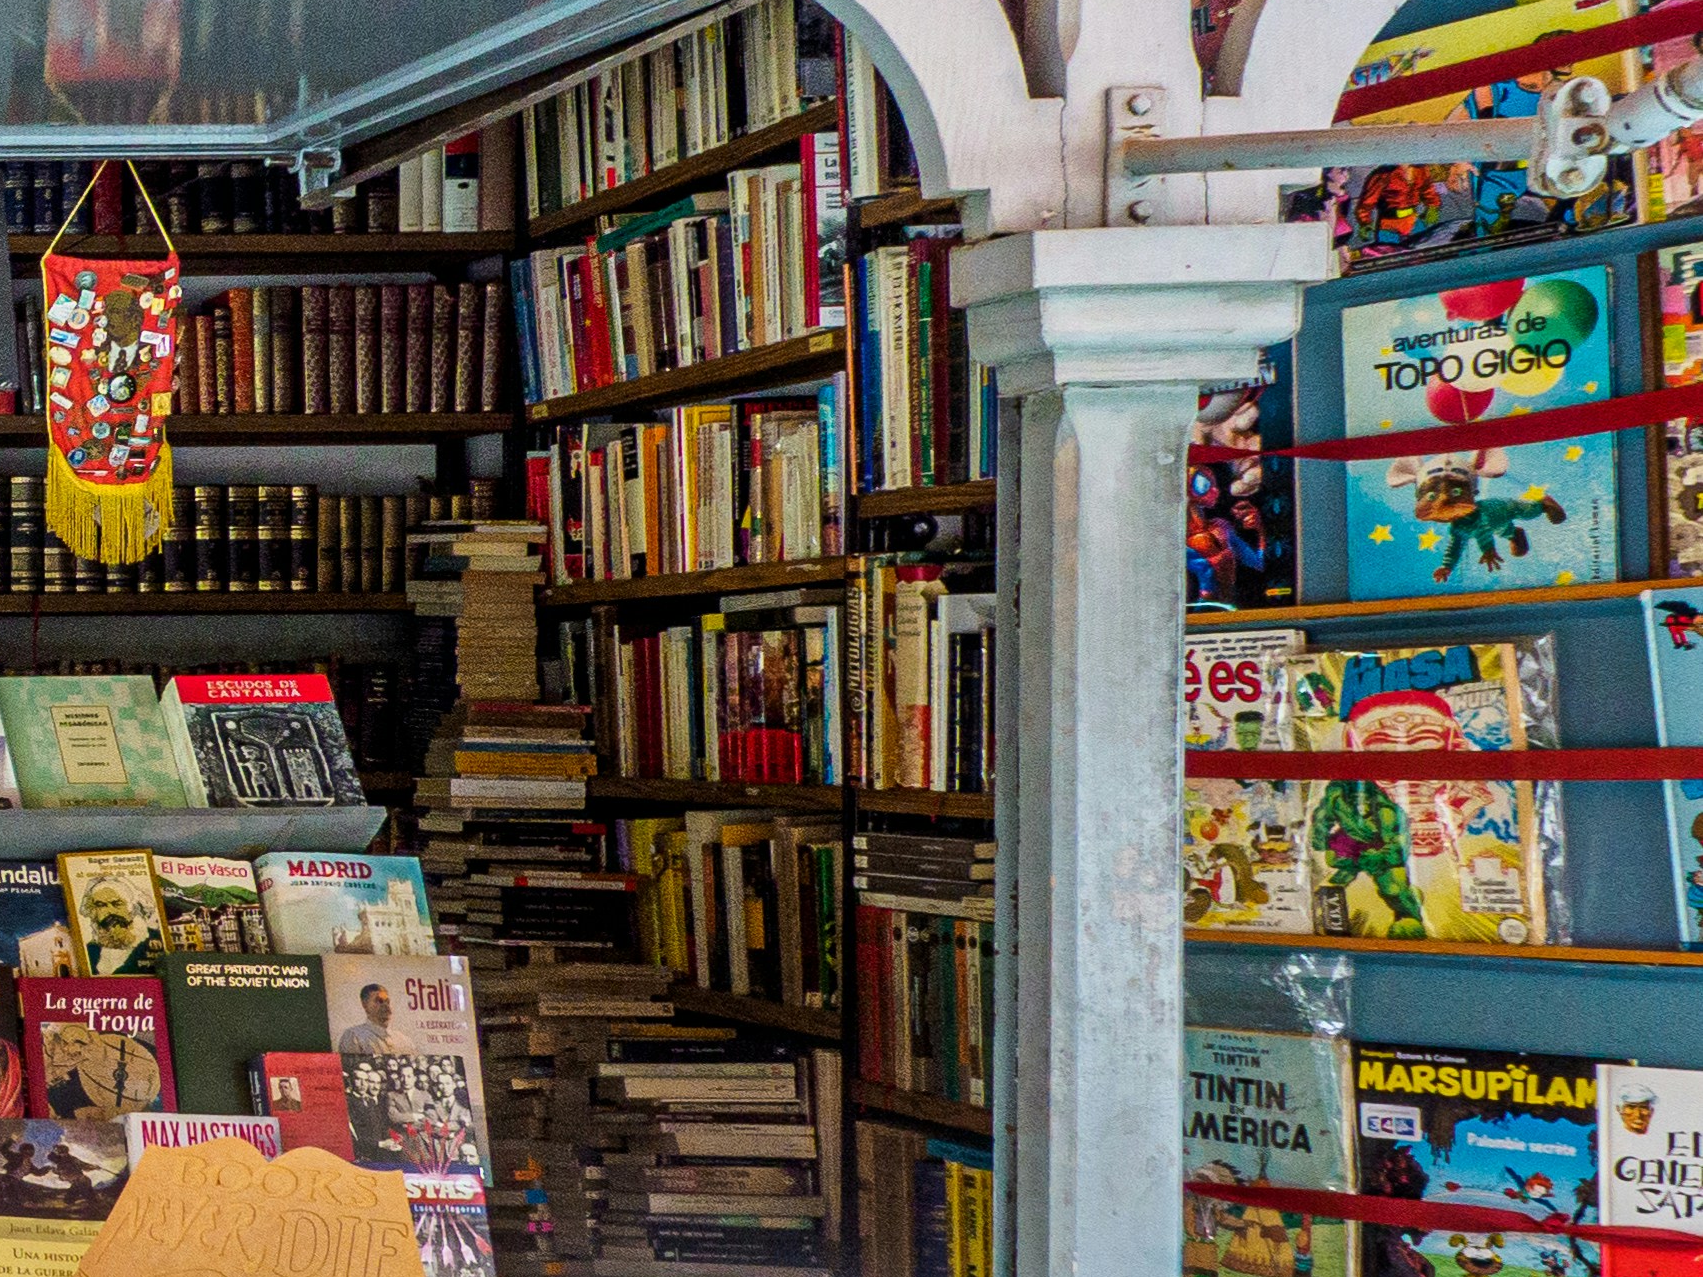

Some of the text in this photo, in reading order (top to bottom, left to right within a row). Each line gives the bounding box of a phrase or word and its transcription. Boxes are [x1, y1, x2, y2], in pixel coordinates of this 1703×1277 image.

[1392, 312, 1547, 353] aventuras de
[1374, 339, 1571, 391] TOPO GIGIO
[206, 680, 298, 691] ESCUDOS DE
[208, 687, 302, 699] CANTABRIA
[287, 859, 373, 881] MADRID
[186, 963, 309, 977] GREAT PATRIOTIC WAR
[187, 975, 311, 989] OF THE SOVIET UNION
[44, 992, 154, 1014] La guerra de
[83, 1008, 156, 1038] Troya
[1212, 1052, 1261, 1068] TINTIN
[1189, 1072, 1286, 1111] TINTIN
